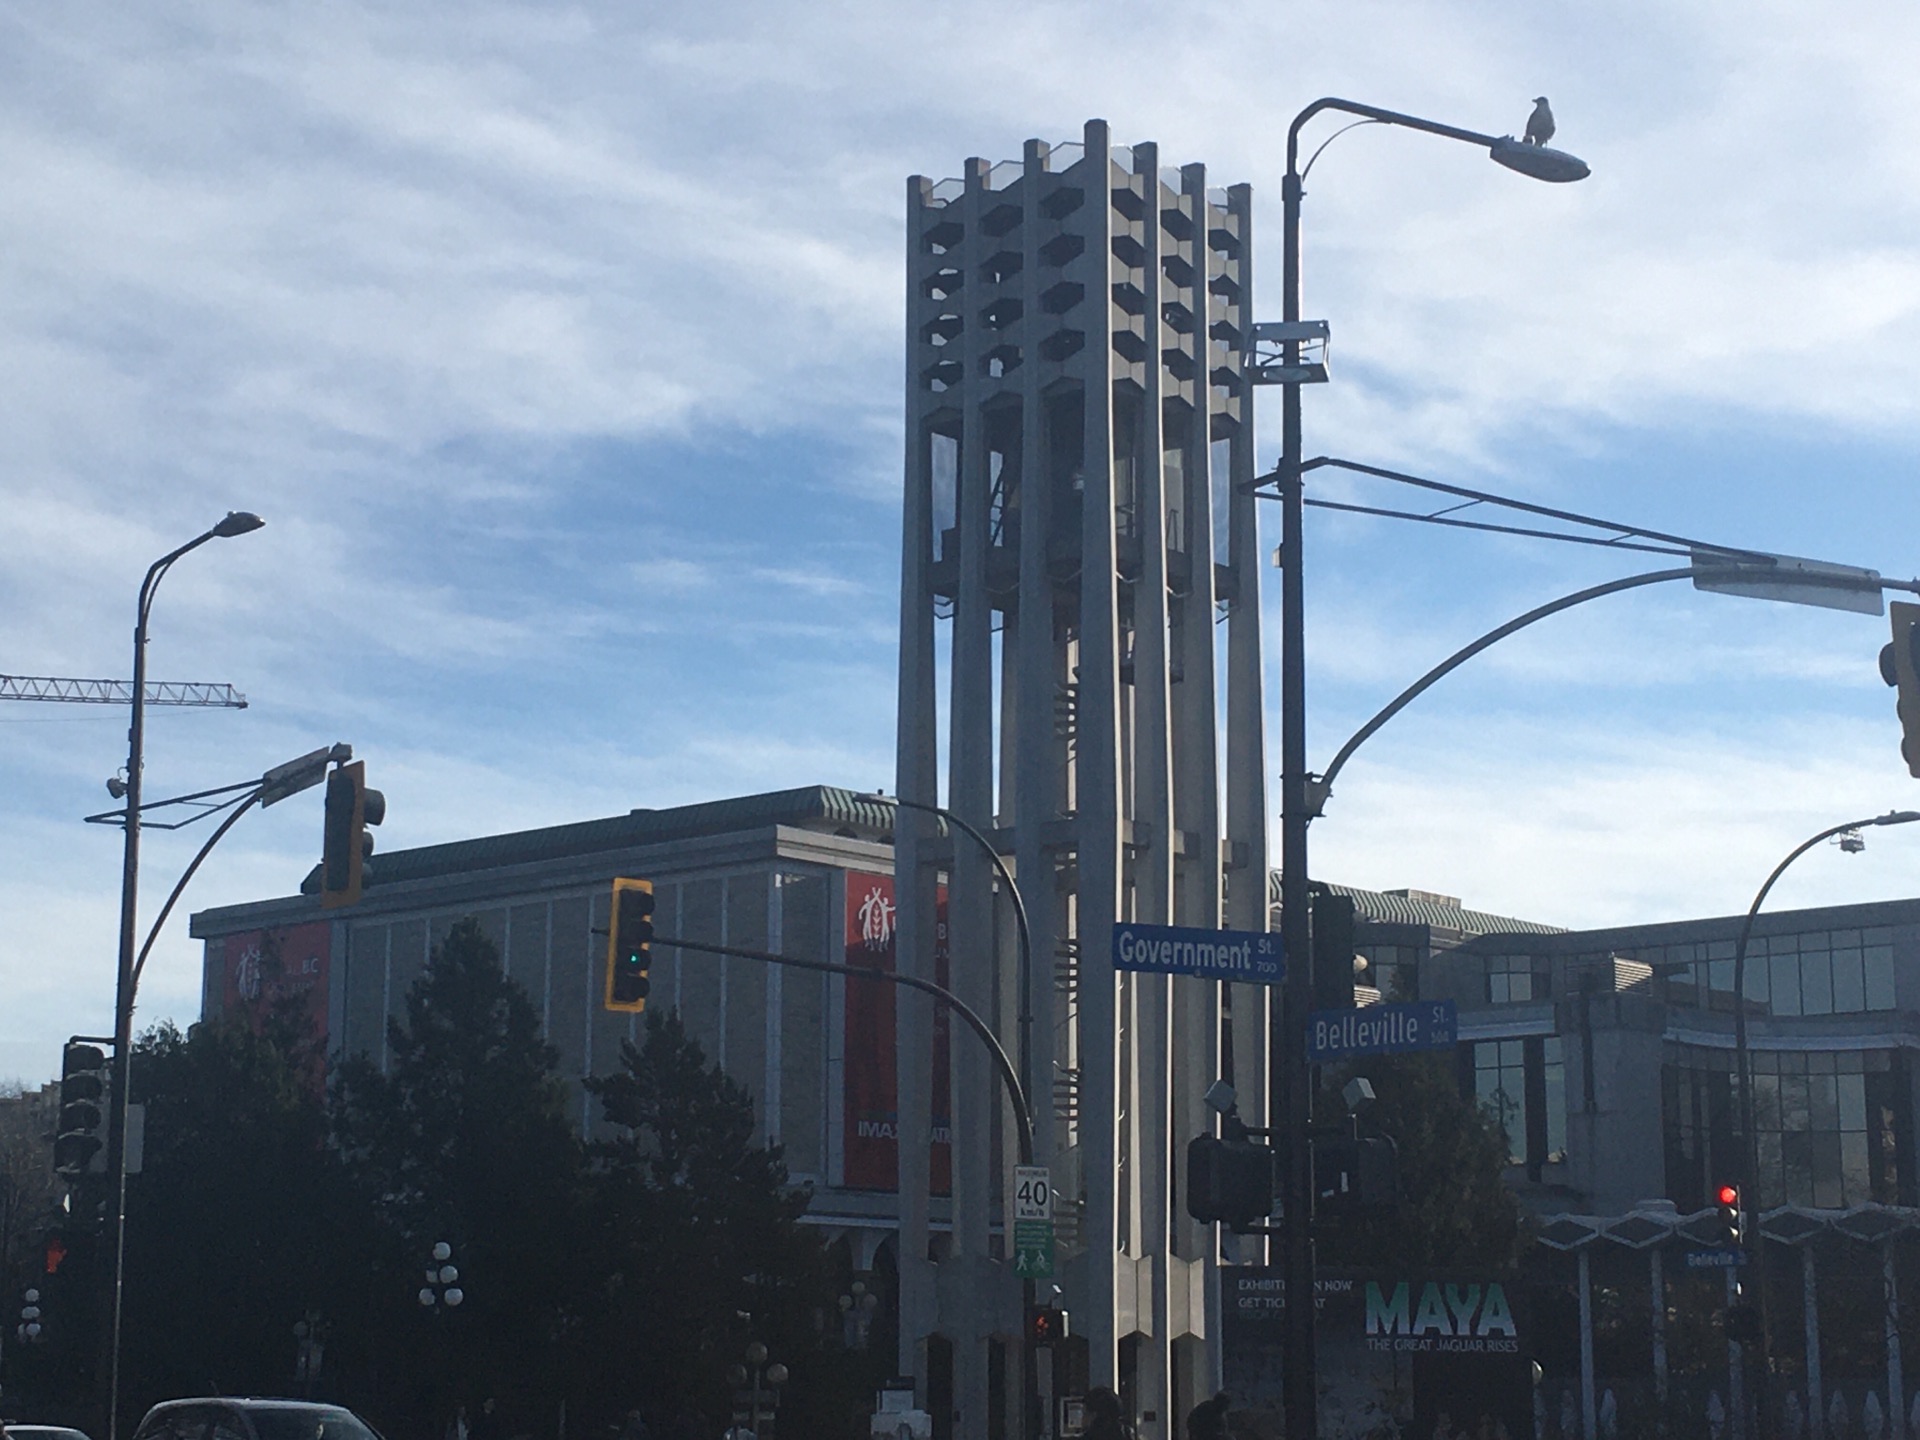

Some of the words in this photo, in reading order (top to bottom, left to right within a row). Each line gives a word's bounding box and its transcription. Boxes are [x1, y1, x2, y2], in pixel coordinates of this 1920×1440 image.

[1119, 930, 1251, 970] Government
[1258, 938, 1276, 955] St.
[1256, 961, 1278, 974] 700
[1316, 1011, 1418, 1050] Belleville
[1432, 1005, 1449, 1023] St.
[1017, 1181, 1047, 1206] 40
[1020, 1207, 1045, 1217] km/h
[1238, 1279, 1286, 1291] EXHIBITI
[1324, 1280, 1354, 1291] NOW
[1238, 1297, 1261, 1309] GET
[1365, 1280, 1518, 1336] MAYA
[1367, 1338, 1390, 1351] THE
[1393, 1338, 1433, 1352] GREAT
[1435, 1339, 1484, 1352] JAGUAR
[1486, 1339, 1519, 1353] RISES
